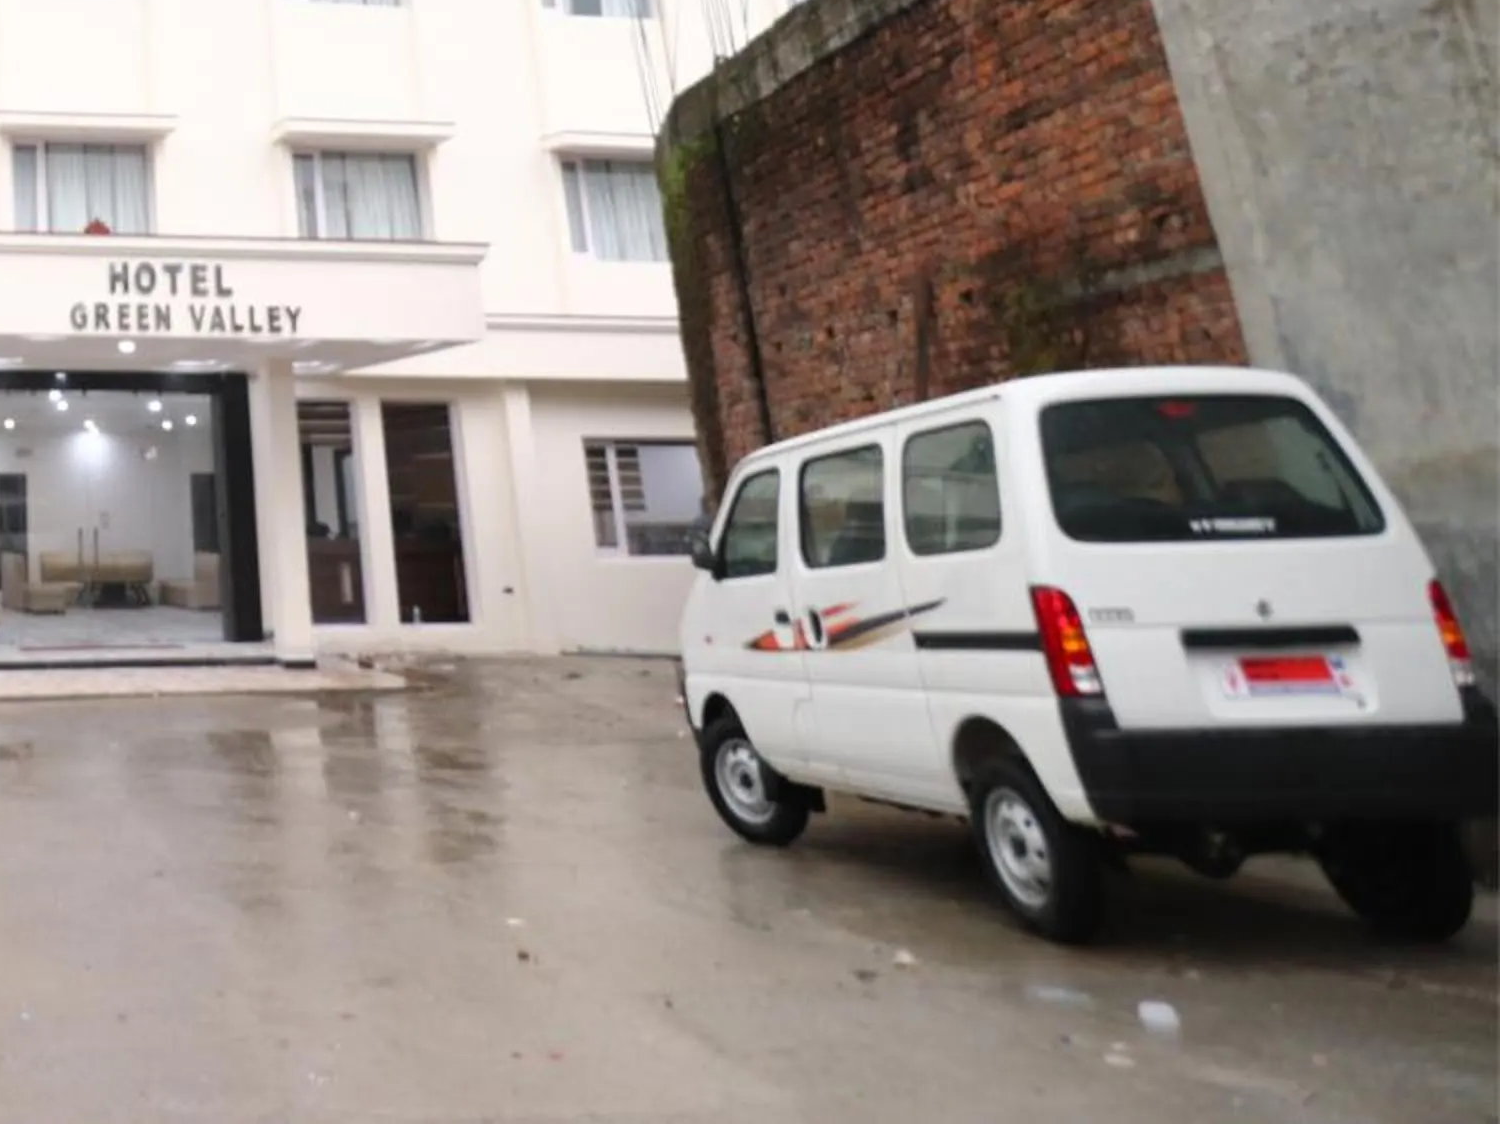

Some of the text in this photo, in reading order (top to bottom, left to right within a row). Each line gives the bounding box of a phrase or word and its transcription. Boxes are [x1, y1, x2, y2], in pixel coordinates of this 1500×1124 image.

[108, 261, 233, 297] HOTEL
[70, 302, 301, 333] GREEN VALLEY
